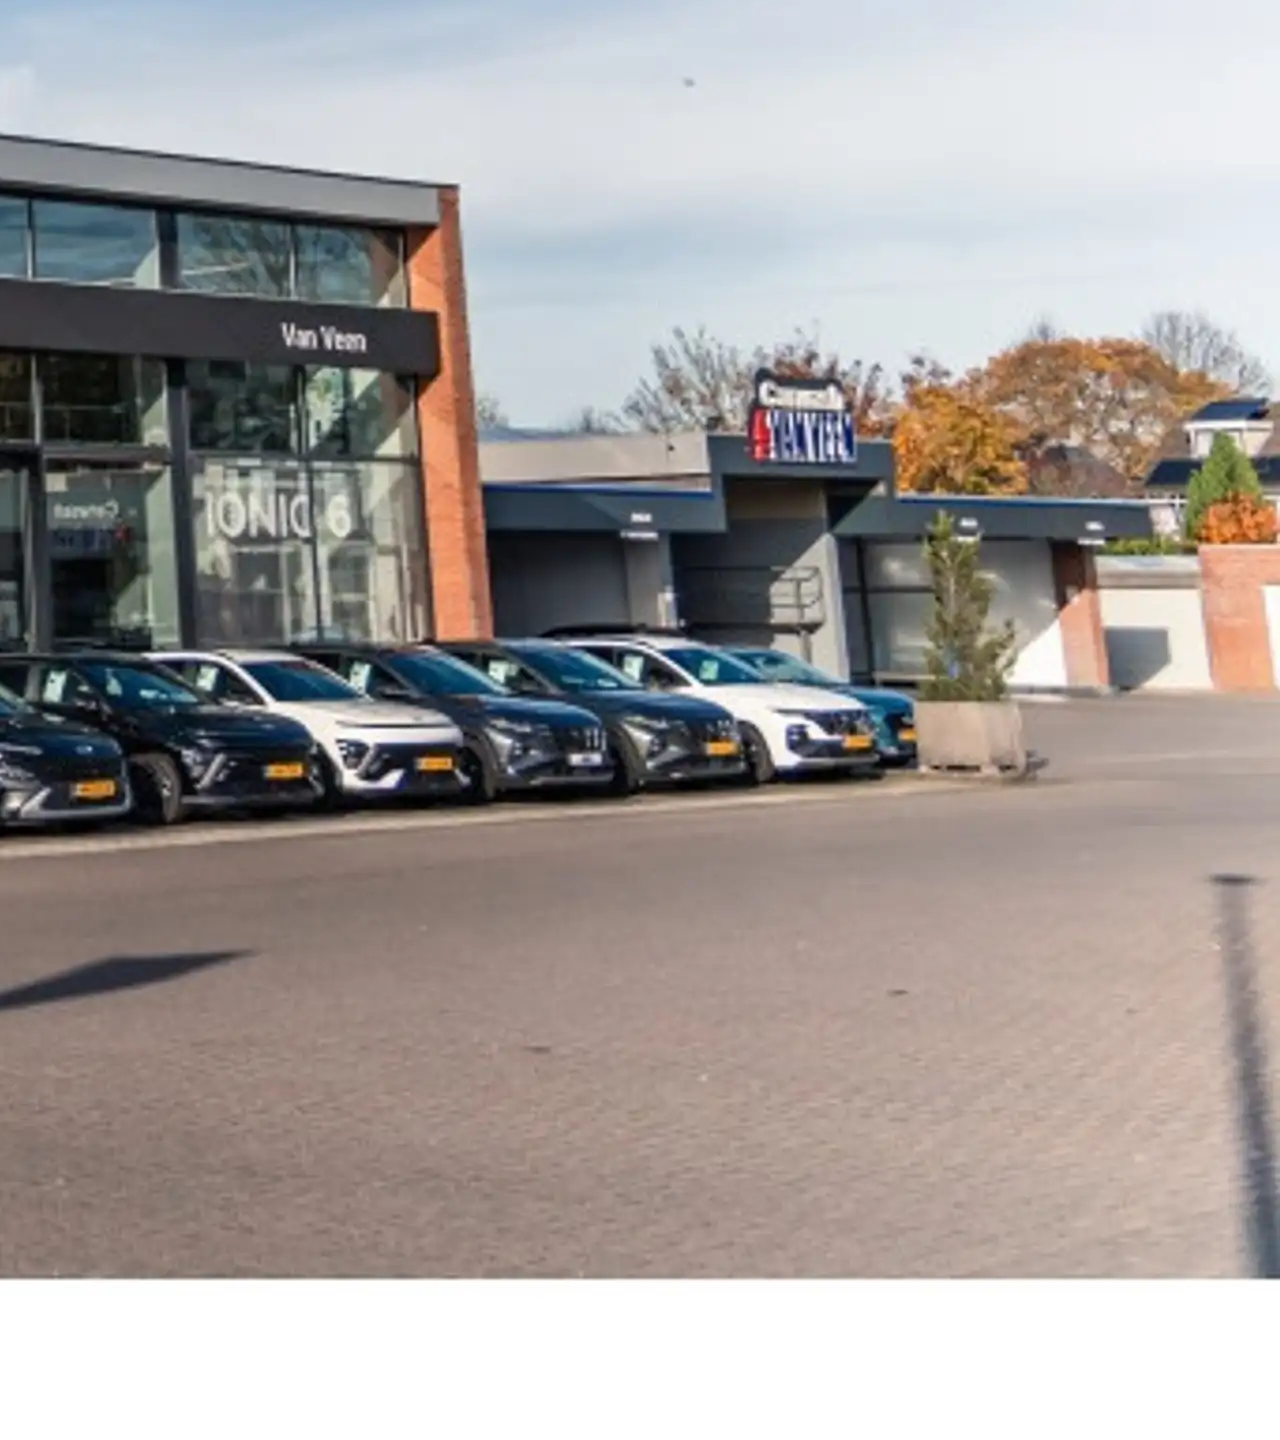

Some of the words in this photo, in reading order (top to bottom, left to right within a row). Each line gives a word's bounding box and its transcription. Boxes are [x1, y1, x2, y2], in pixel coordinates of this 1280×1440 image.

[281, 322, 318, 350] Van
[320, 325, 367, 353] Veen
[328, 493, 352, 539] 6
